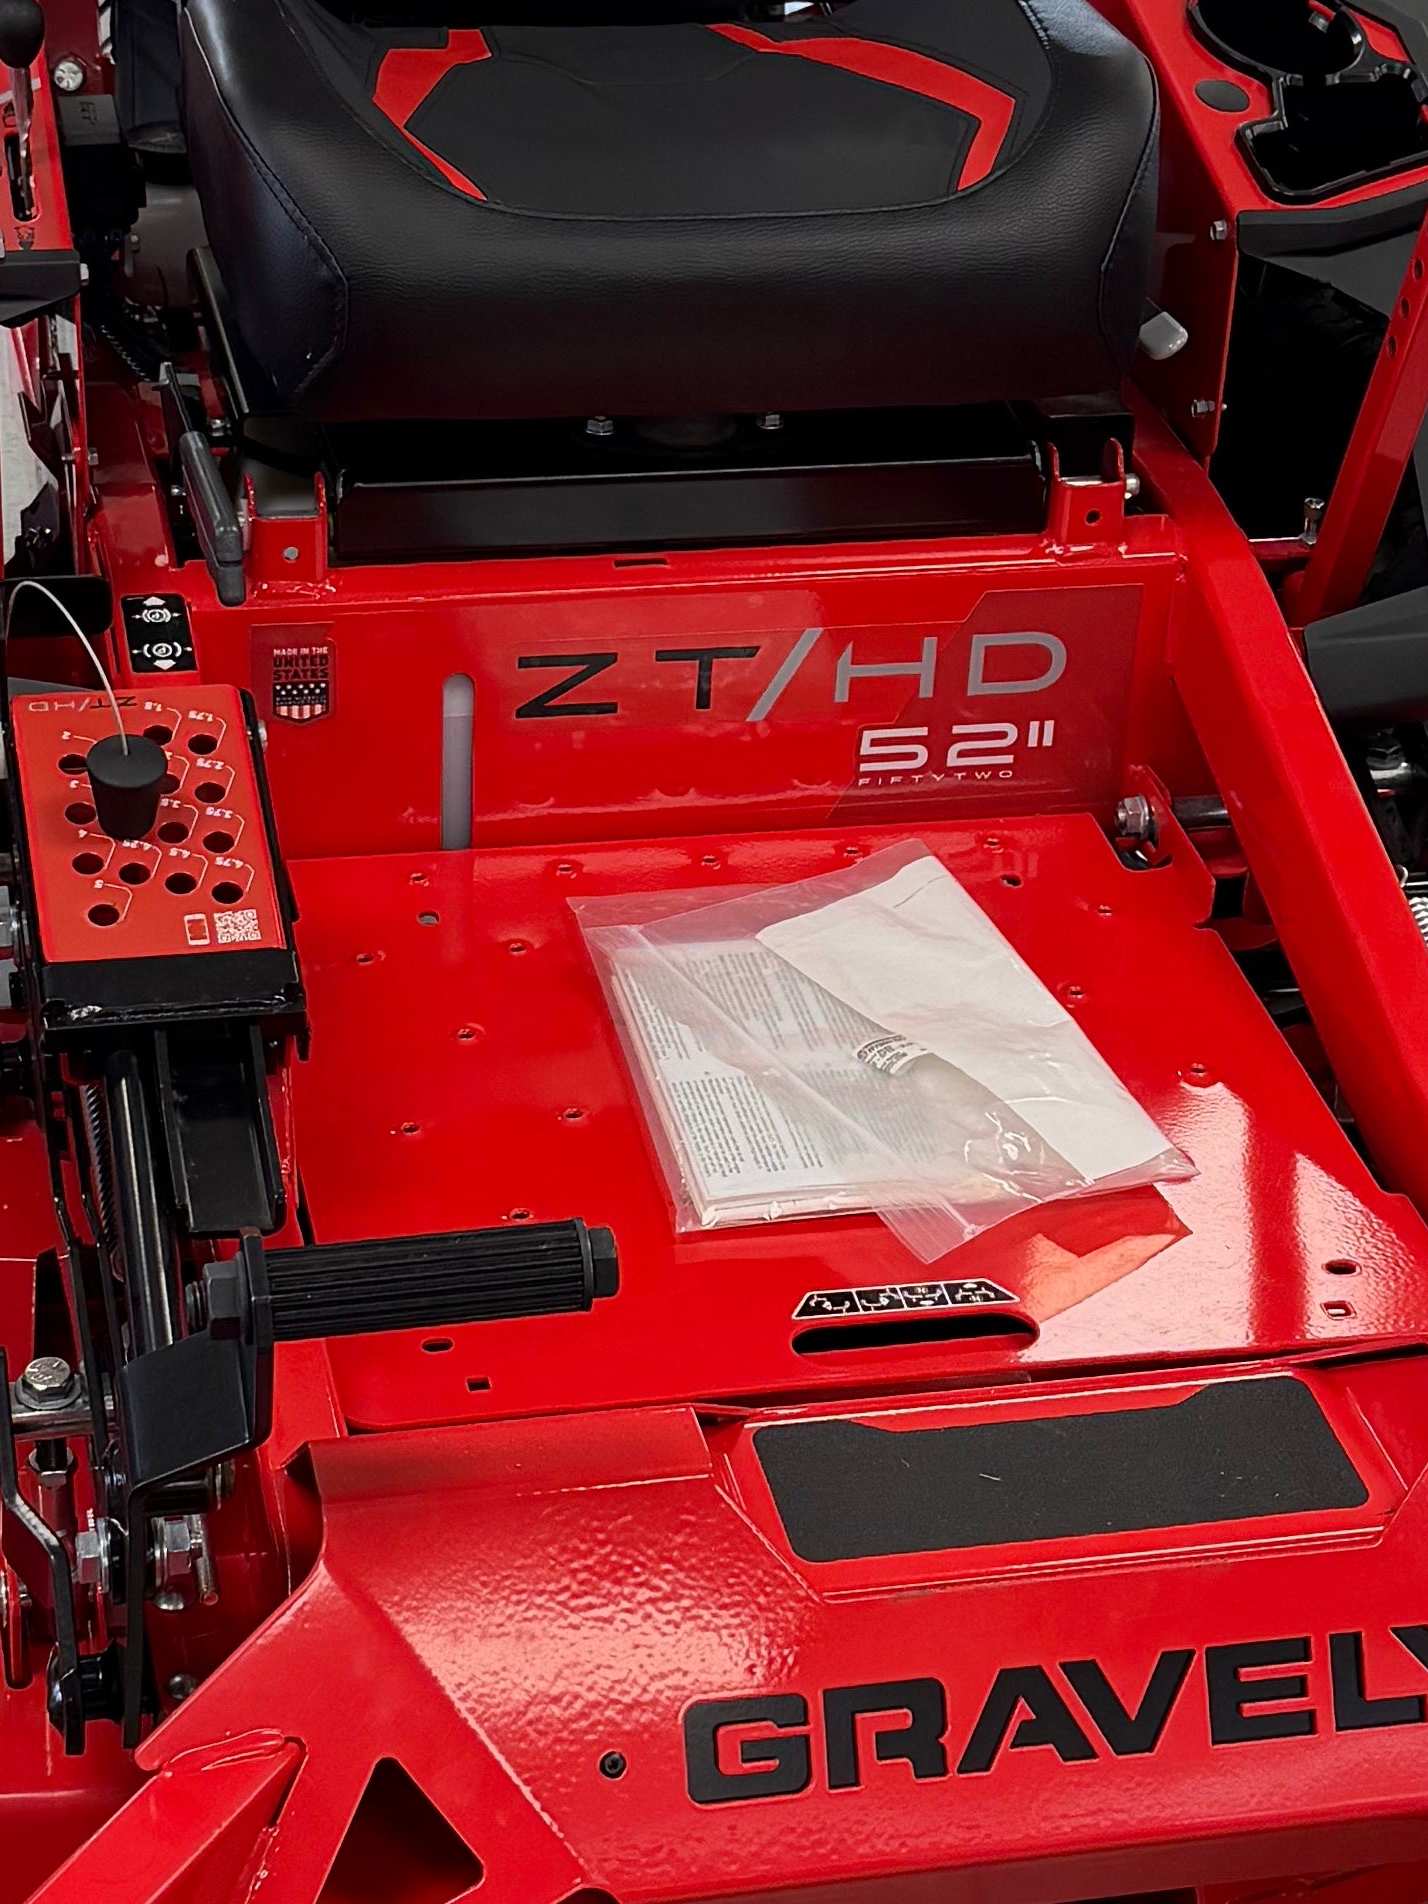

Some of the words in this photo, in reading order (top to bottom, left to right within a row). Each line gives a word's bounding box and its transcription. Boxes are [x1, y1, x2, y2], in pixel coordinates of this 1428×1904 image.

[273, 647, 298, 656] MADE
[300, 647, 310, 655] IN
[312, 646, 329, 655] THE
[273, 655, 329, 668] UNITED
[273, 667, 329, 681] STATES
[857, 769, 1014, 788] FIFTYTWO
